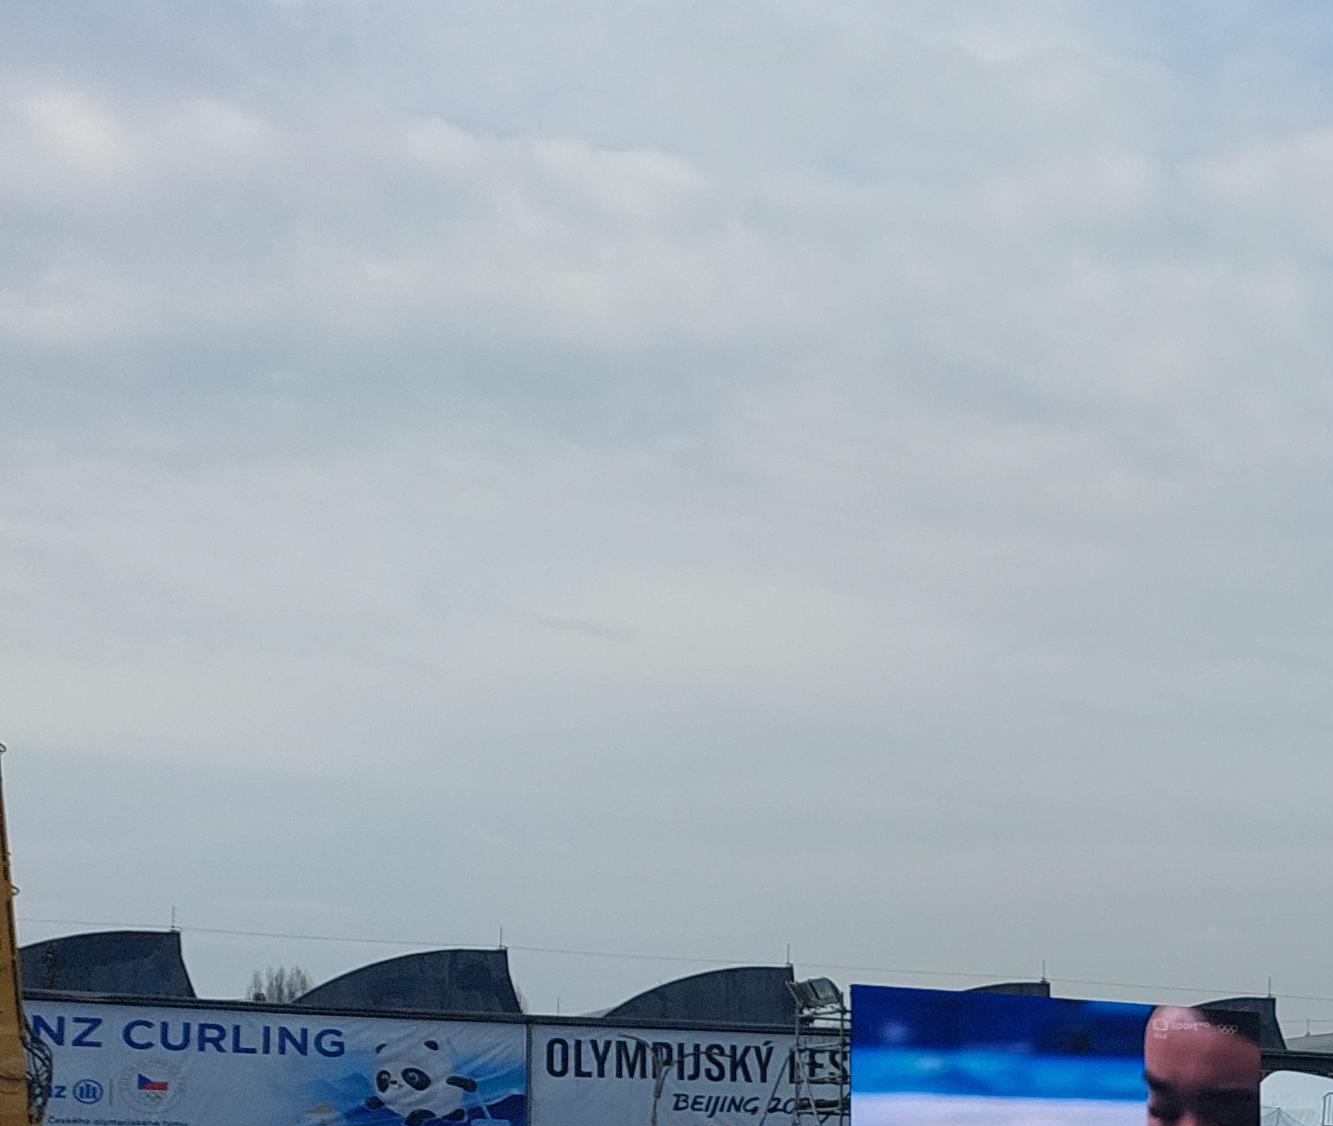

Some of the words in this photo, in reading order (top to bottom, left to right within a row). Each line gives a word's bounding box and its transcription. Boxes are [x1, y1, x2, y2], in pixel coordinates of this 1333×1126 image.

[122, 1020, 346, 1058] CURLING
[545, 1038, 774, 1083] OLYMPIJSKÝ
[672, 1093, 761, 1118] BEIJING
